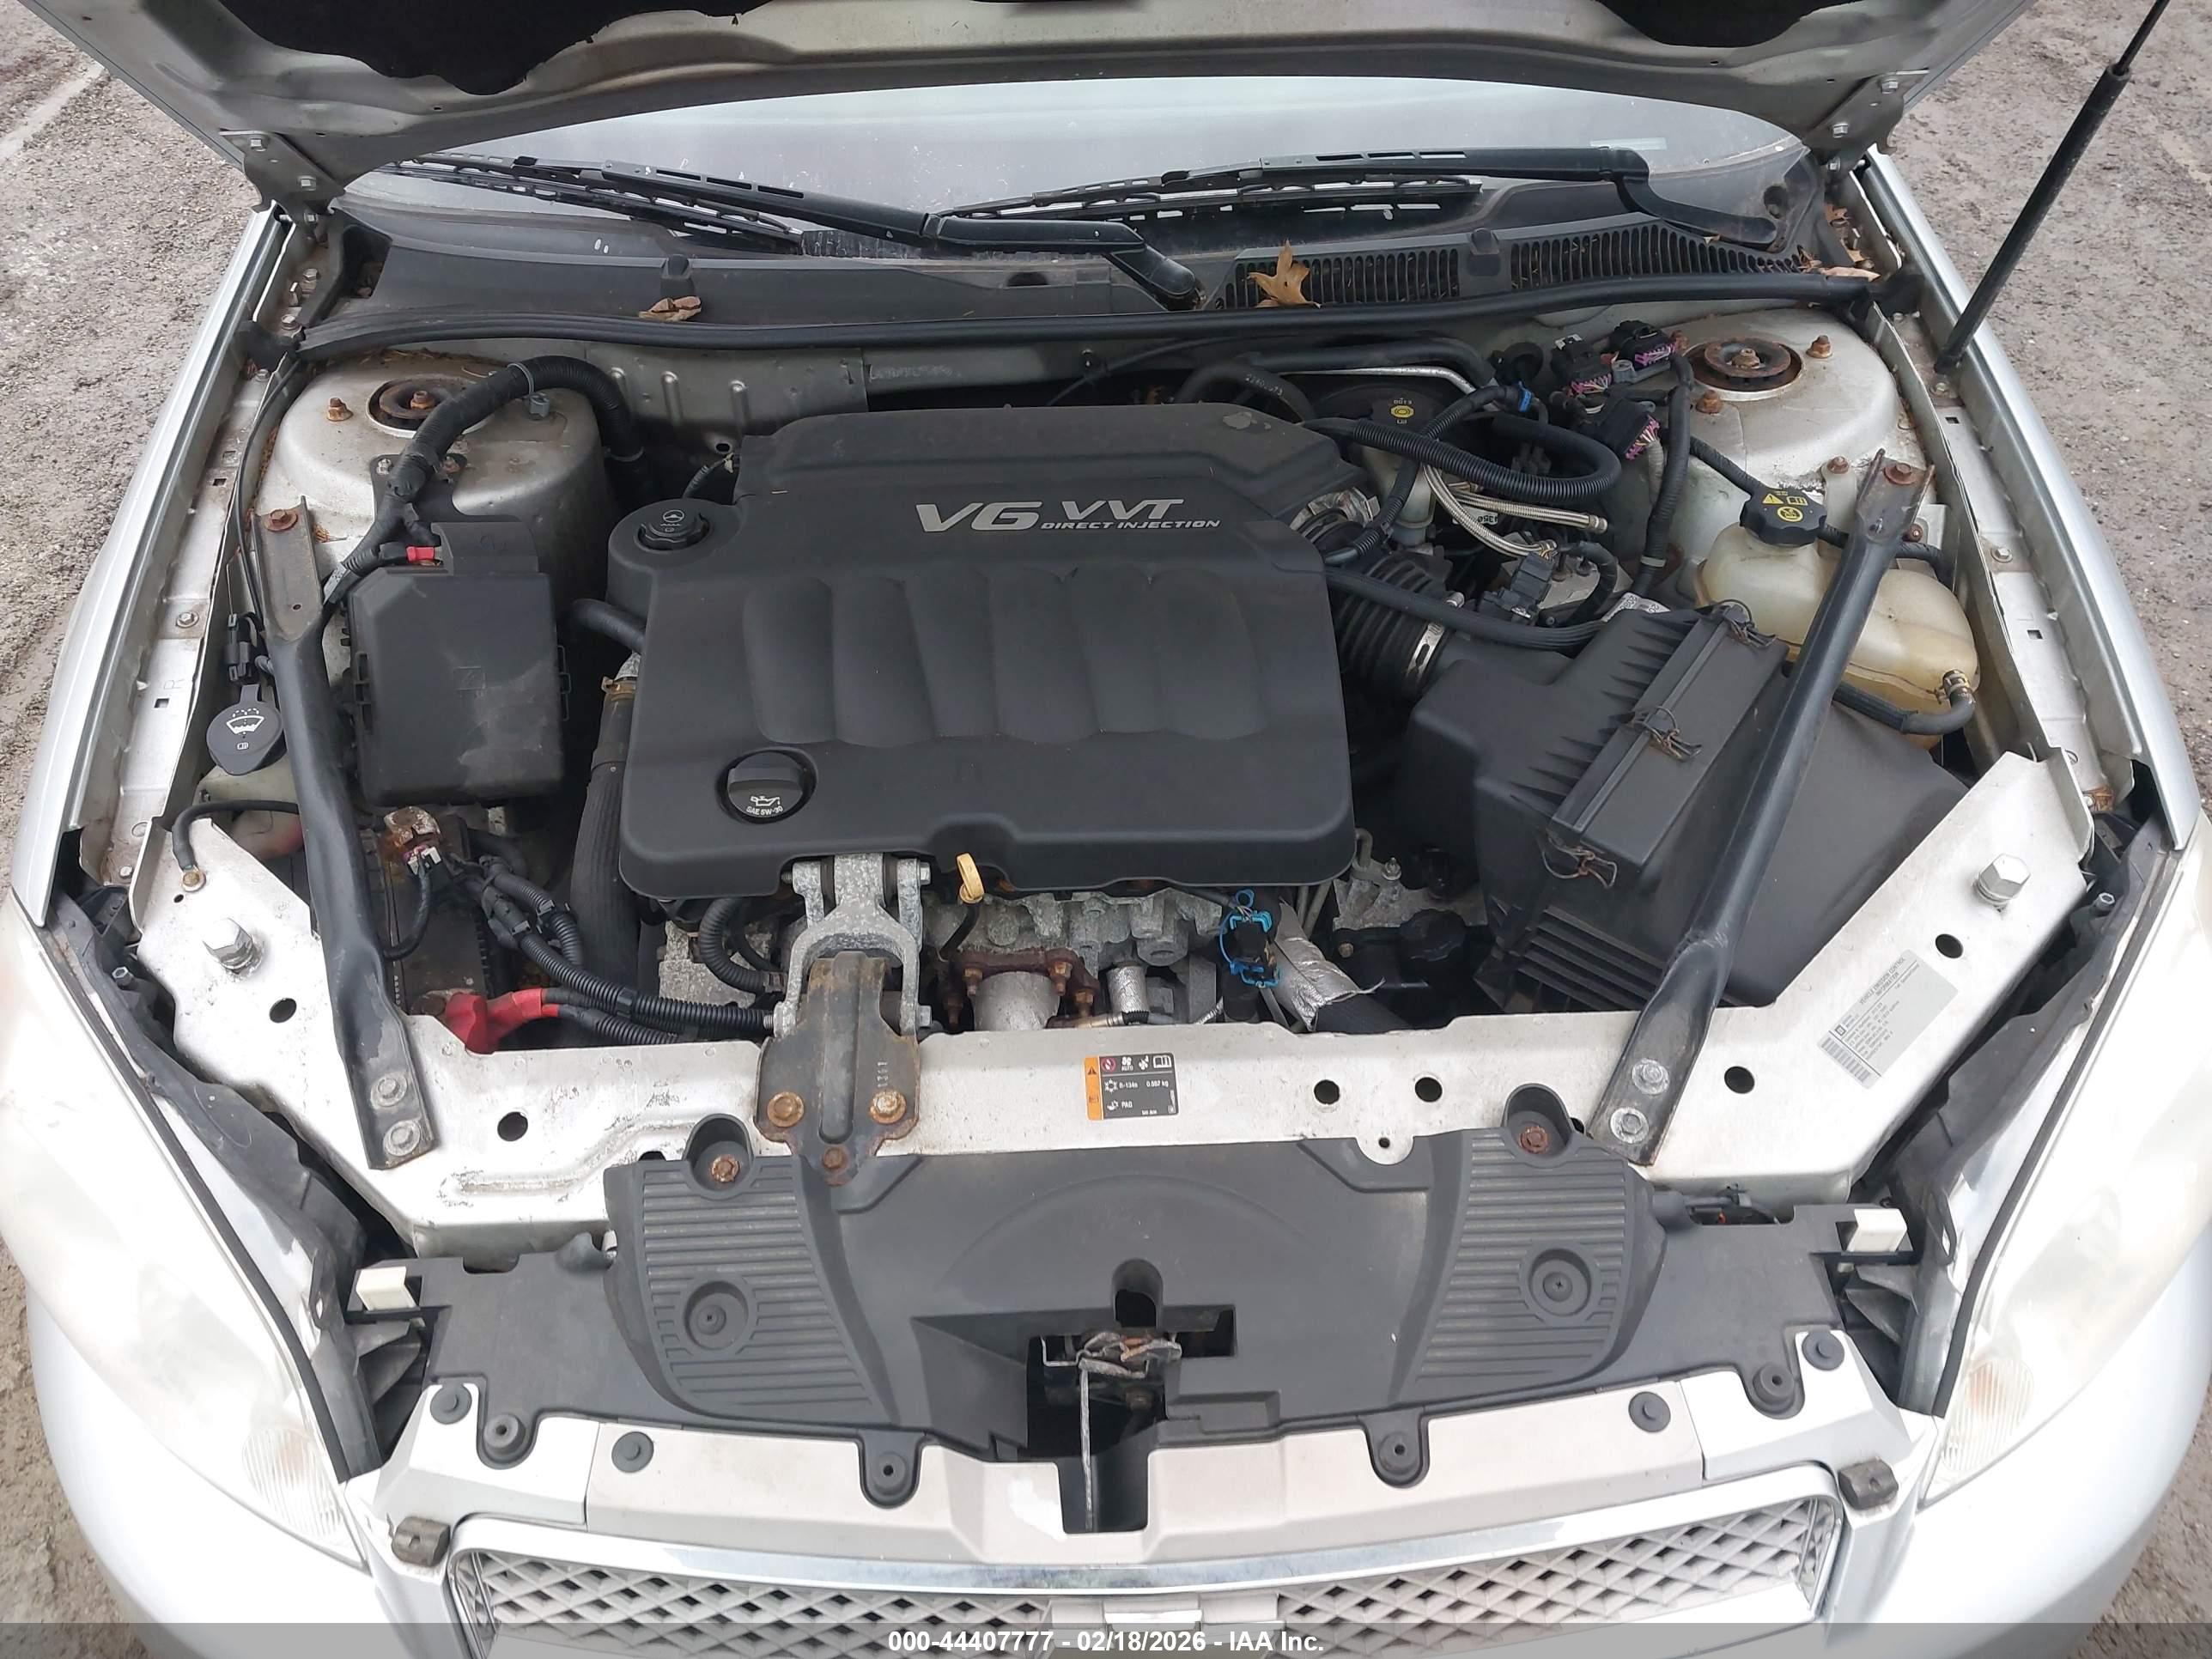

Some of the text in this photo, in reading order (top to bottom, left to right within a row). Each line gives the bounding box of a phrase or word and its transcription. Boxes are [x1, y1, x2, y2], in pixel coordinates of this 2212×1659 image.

[915, 499, 1184, 532] V6 VVT
[1041, 520, 1221, 530] DIRECT INJECTION
[746, 805, 783, 816] SAE 5W-30
